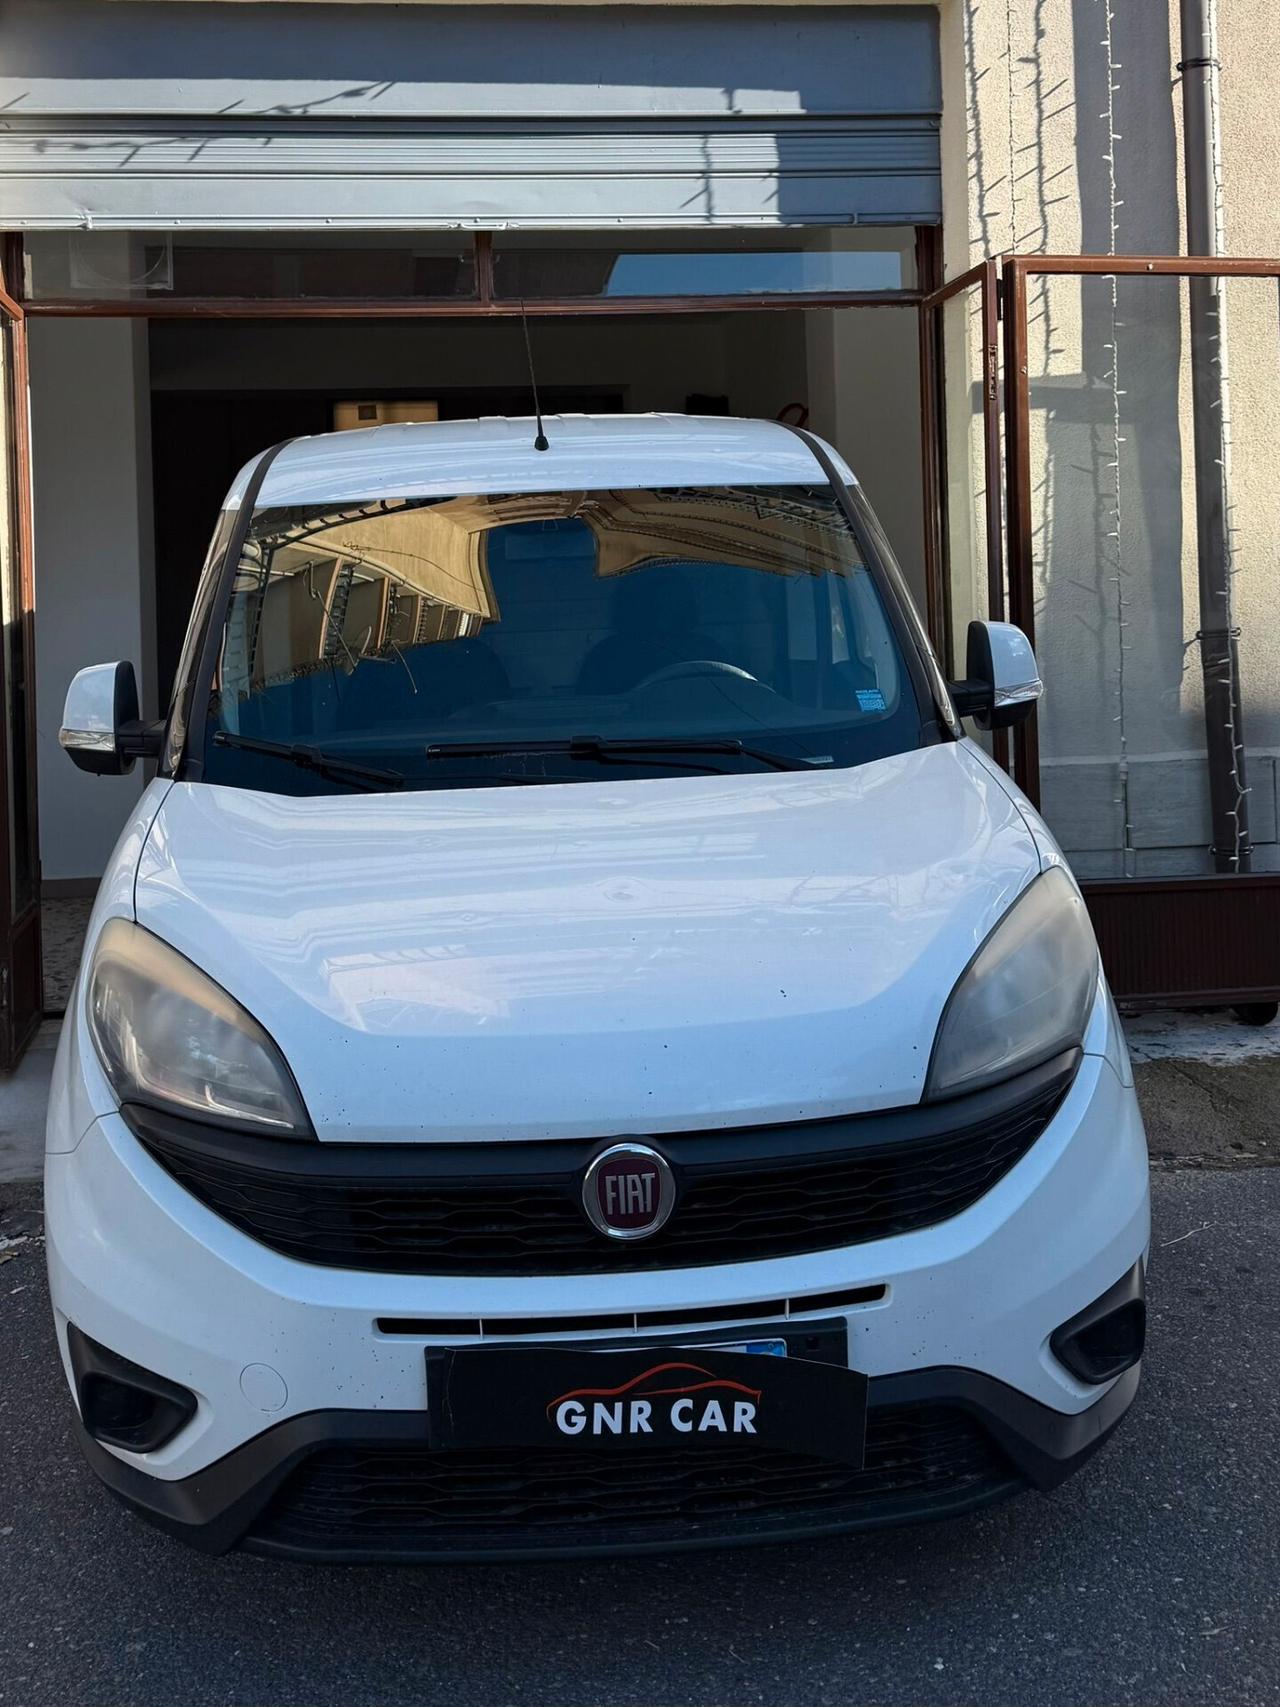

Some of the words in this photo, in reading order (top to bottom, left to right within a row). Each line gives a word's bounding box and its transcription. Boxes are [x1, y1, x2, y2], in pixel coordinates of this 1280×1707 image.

[605, 1172, 656, 1216] FIAT
[556, 1400, 653, 1435] GNR
[670, 1398, 757, 1434] CAR
